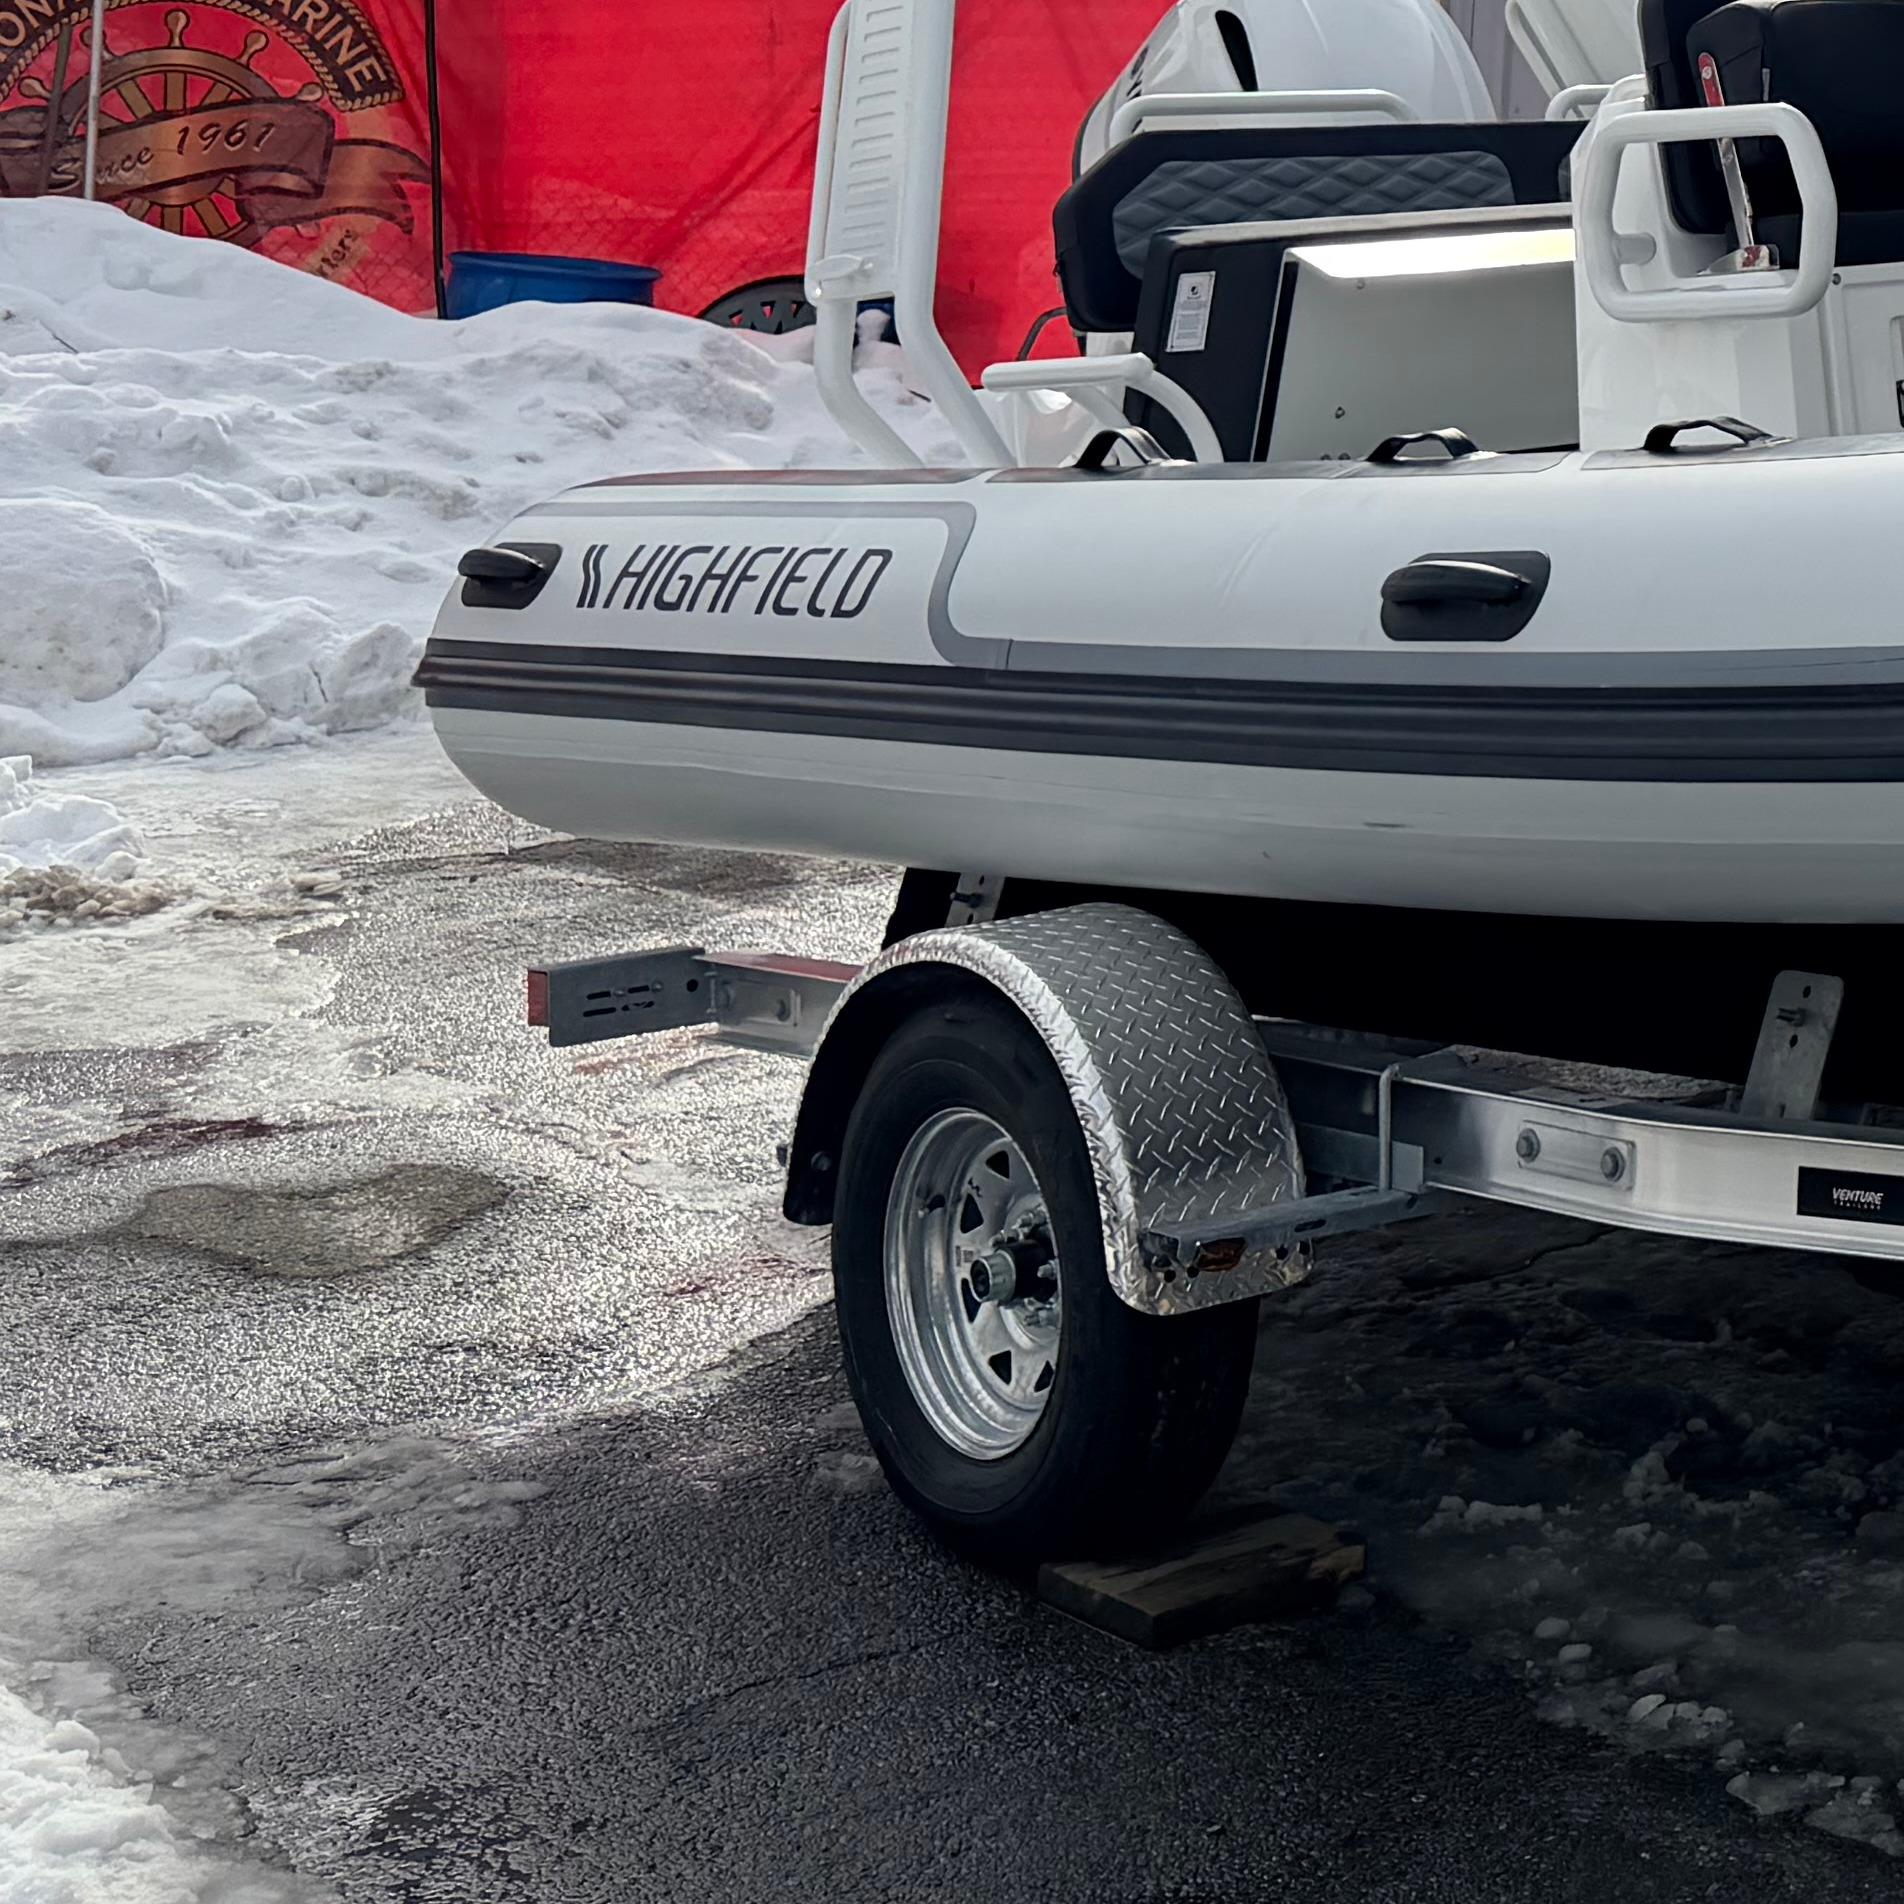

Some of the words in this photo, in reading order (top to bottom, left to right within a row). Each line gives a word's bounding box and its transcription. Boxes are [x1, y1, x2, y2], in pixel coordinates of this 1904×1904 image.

[176, 118, 276, 156] 1961
[602, 544, 893, 618] HIGHFIELD
[1832, 1186, 1884, 1205] VENTURE
